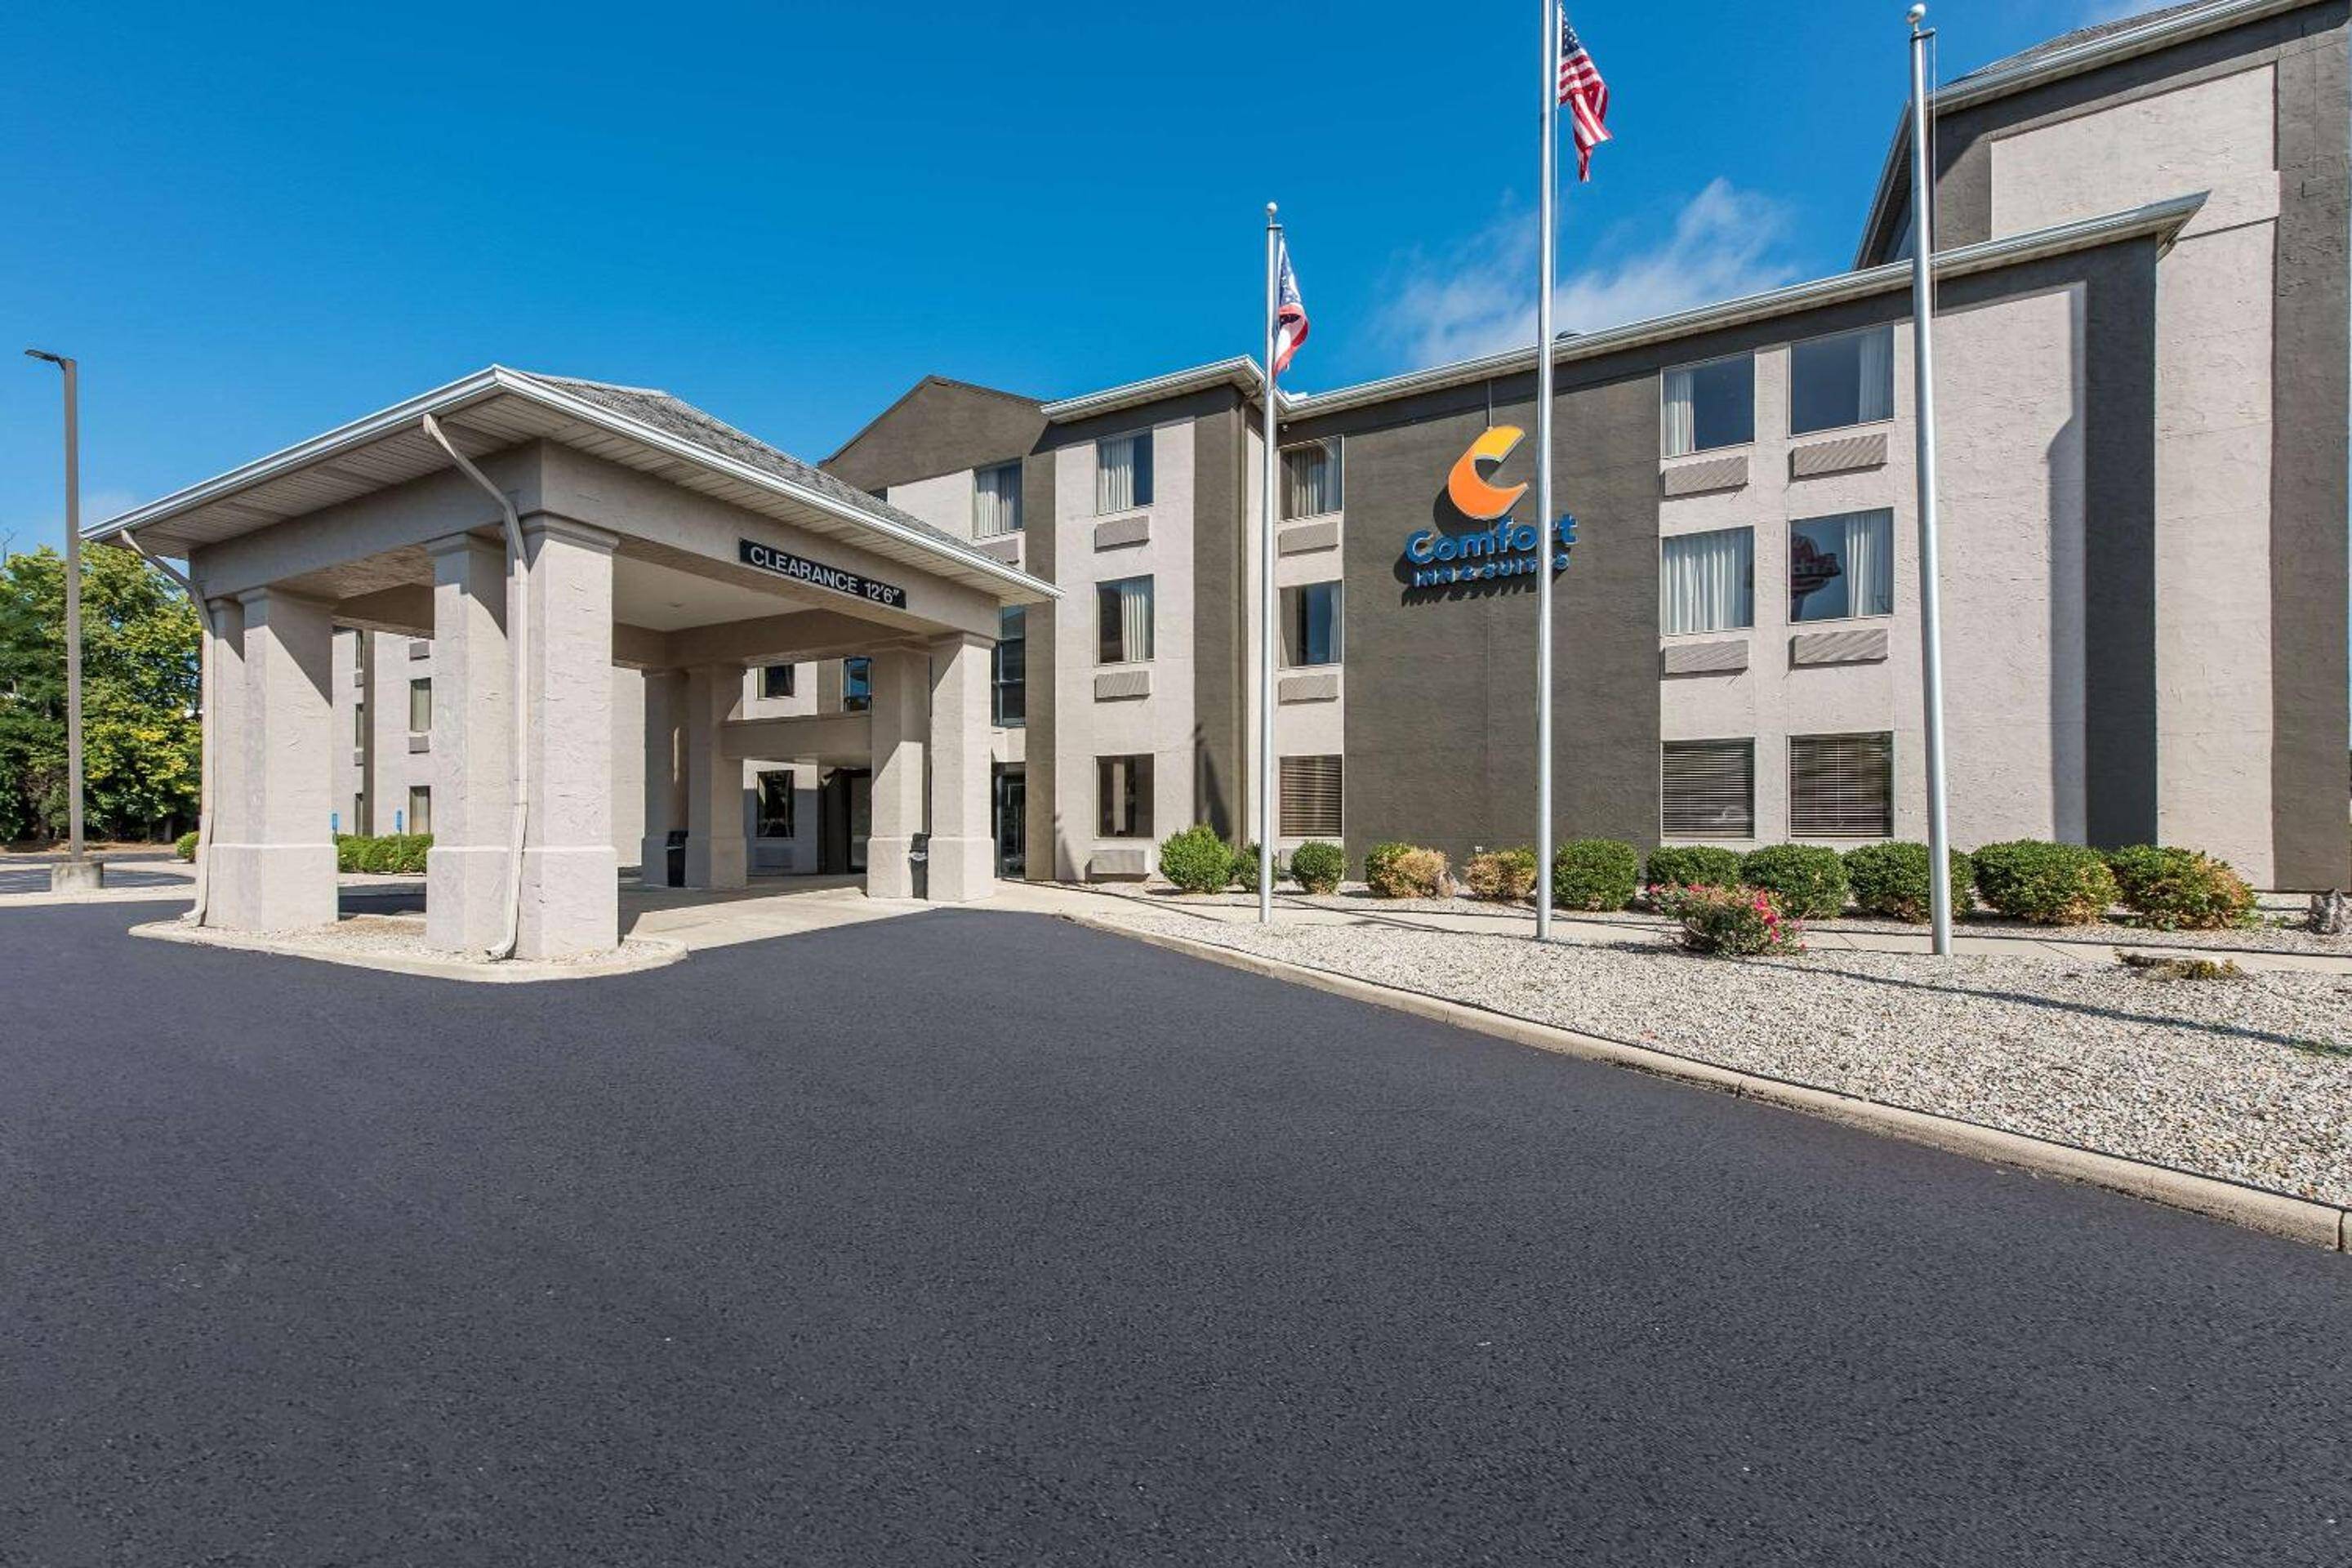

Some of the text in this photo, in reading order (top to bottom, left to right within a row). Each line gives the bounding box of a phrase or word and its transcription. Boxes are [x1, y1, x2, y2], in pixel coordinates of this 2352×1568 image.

[1405, 514, 1578, 564] Comfot
[751, 546, 858, 593] CLEARANCE
[1415, 554, 1569, 586] INN & SUITS
